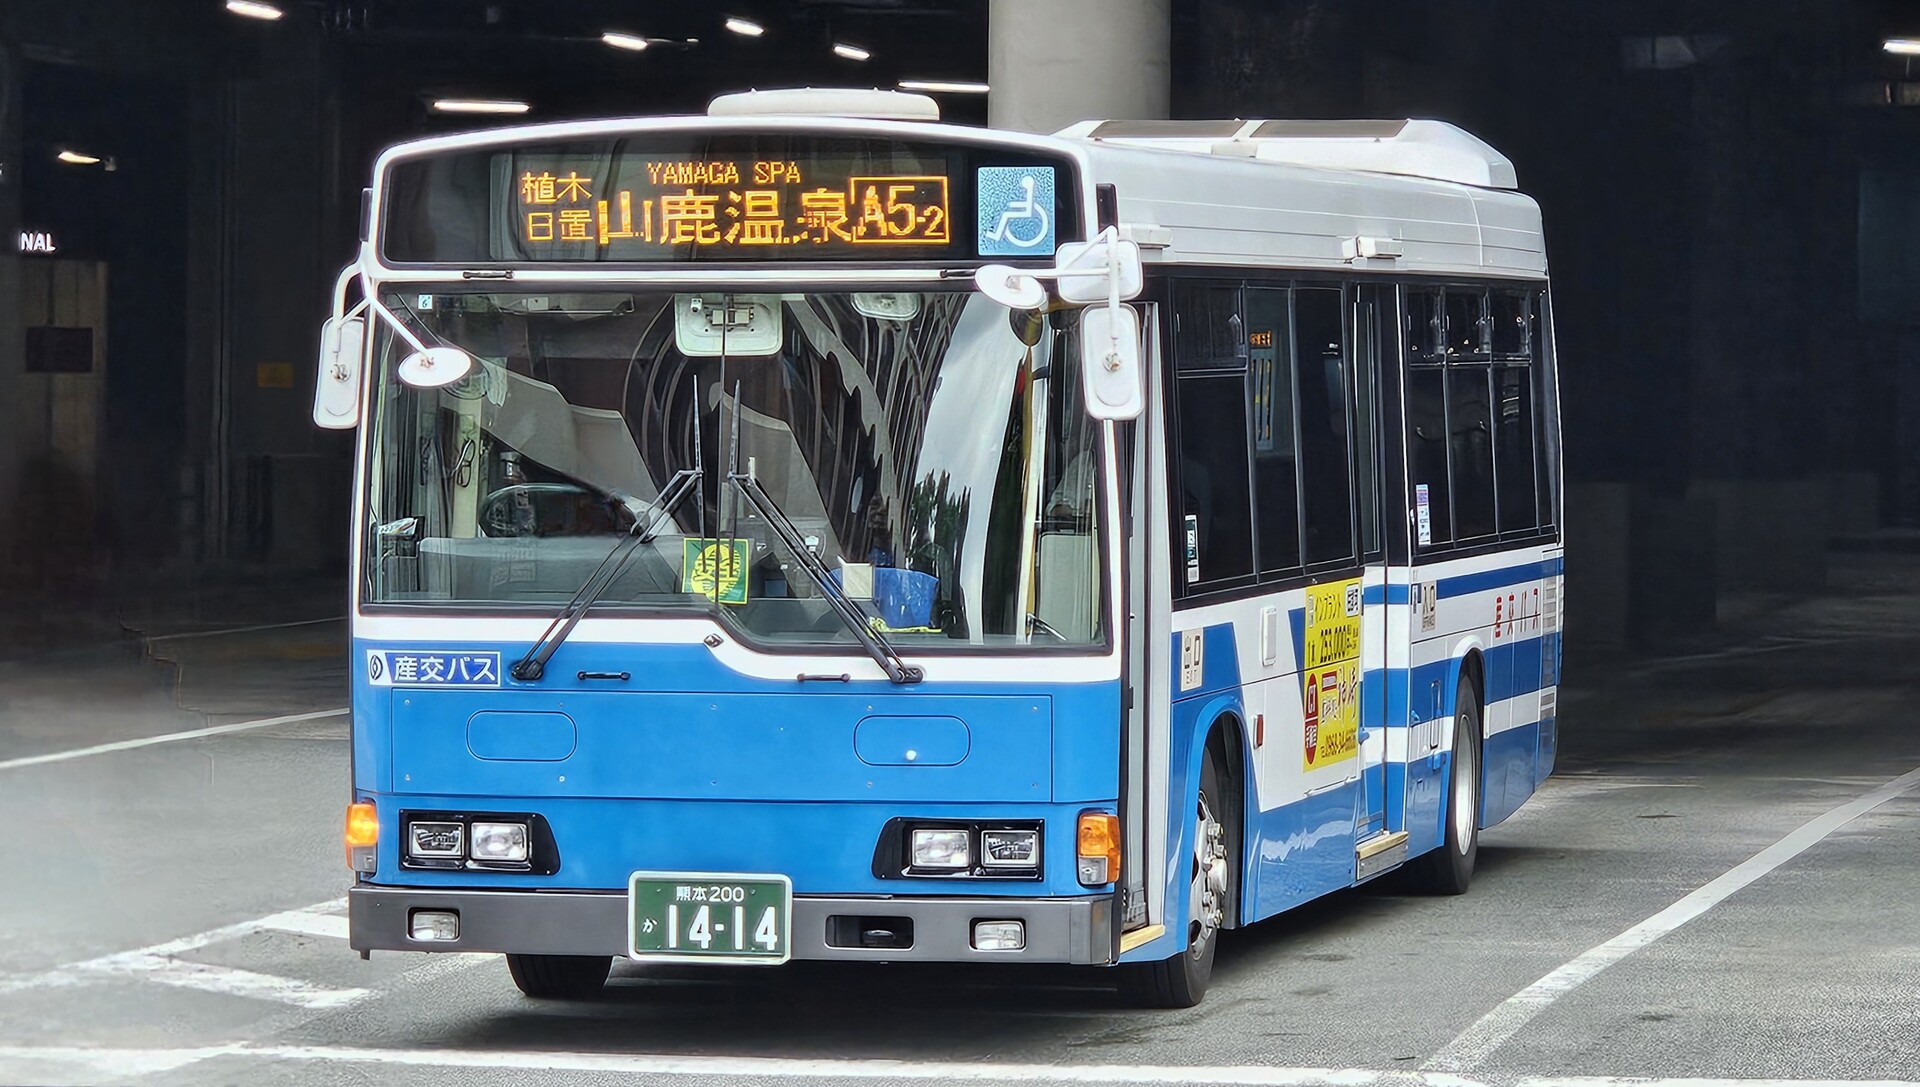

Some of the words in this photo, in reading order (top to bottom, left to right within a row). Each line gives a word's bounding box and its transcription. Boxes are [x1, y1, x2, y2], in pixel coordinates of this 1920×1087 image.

[521, 171, 593, 204] 植木
[647, 161, 739, 184] YAMAGA
[754, 161, 801, 184] SPA
[527, 209, 594, 241] 日置
[597, 187, 852, 245] 山鹿温泉
[20, 232, 56, 252] NAL
[394, 655, 496, 682] 産交バス
[642, 917, 658, 934] か
[668, 904, 778, 951] 14-14
